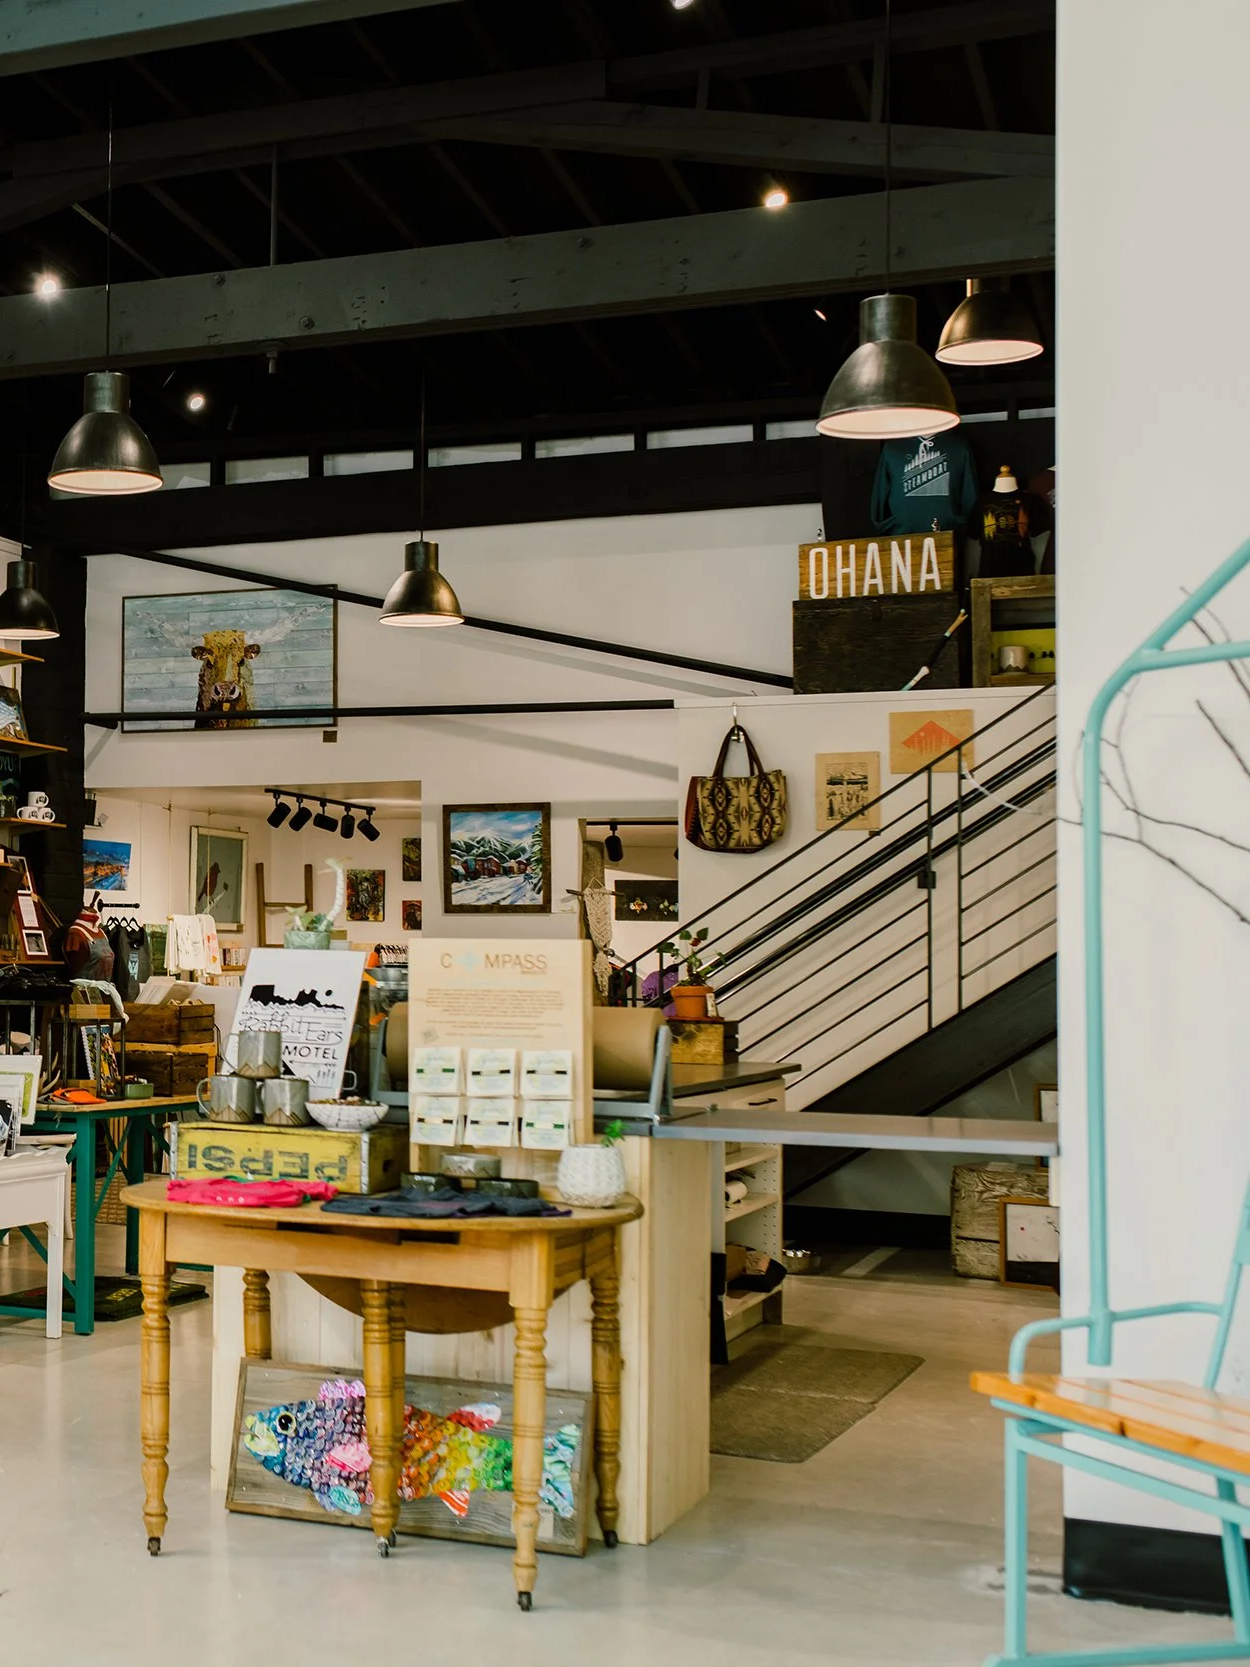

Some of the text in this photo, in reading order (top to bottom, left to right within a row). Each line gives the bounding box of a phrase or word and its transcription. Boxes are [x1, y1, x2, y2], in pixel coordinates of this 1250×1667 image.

[903, 461, 948, 493] STEAMBOAT
[809, 537, 942, 600] OHANA
[440, 952, 548, 970] CMPASS
[282, 1045, 339, 1060] MOTEL
[188, 1144, 348, 1181] PEPSI
